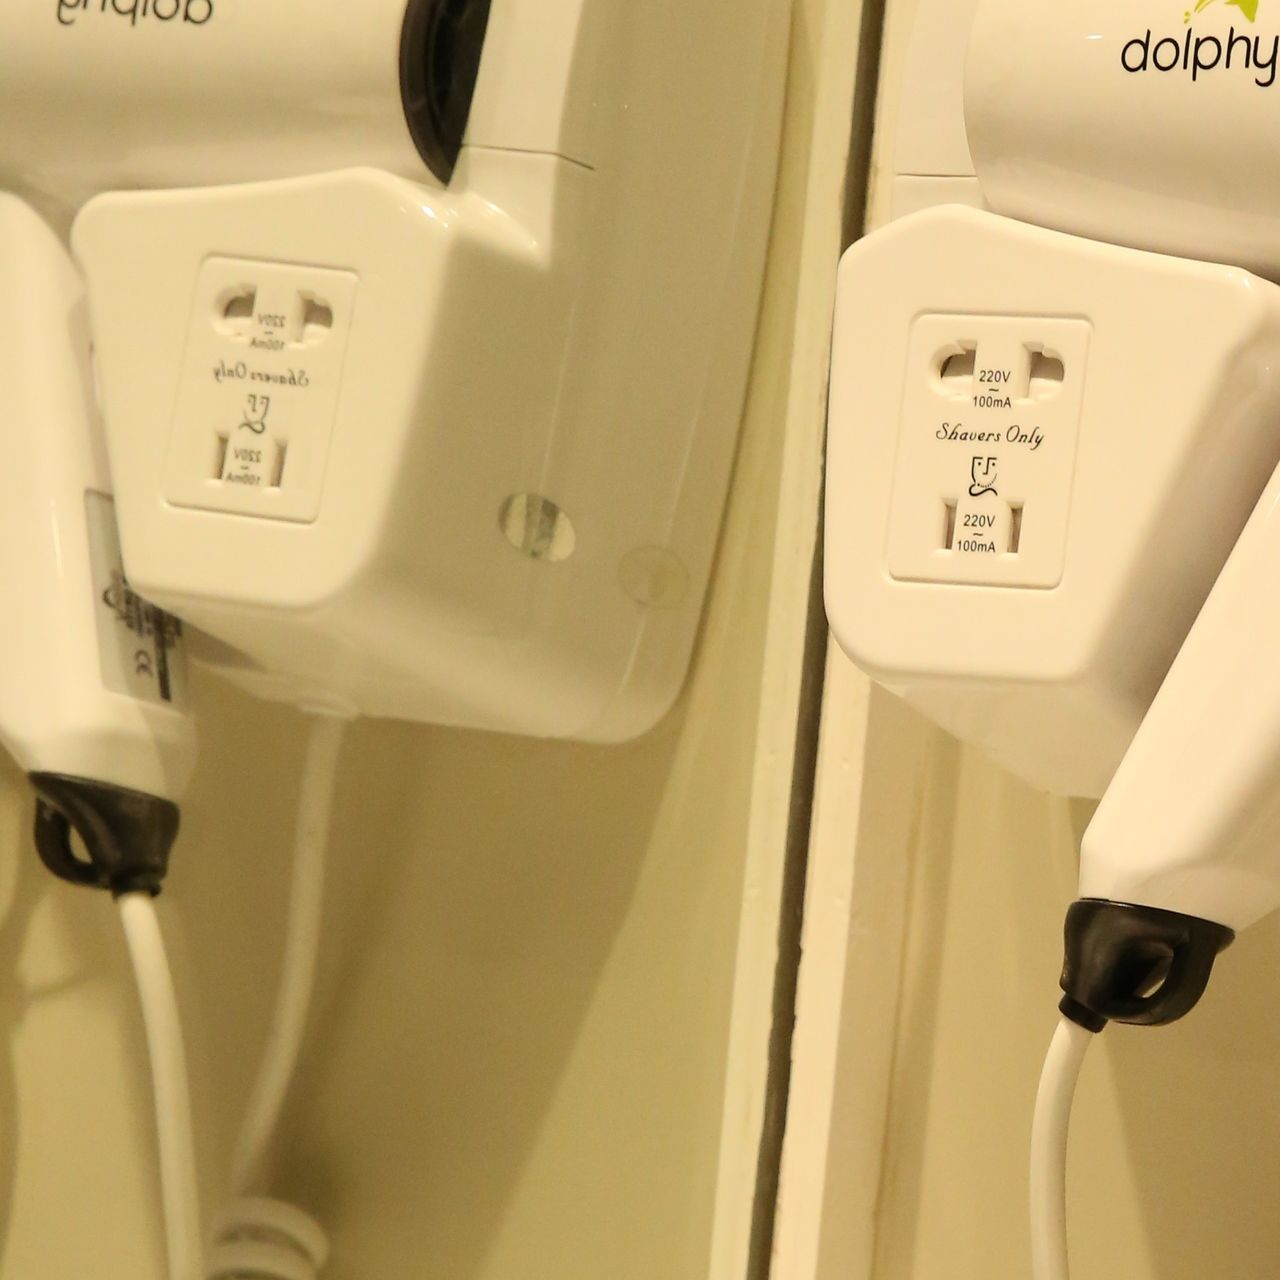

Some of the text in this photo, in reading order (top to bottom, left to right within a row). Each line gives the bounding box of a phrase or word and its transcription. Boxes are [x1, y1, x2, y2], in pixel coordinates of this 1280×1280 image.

[978, 369, 1012, 384] 220V
[972, 395, 1012, 409] 100mA
[935, 422, 1045, 451] Shavers Only
[962, 514, 996, 528] 220V
[956, 540, 997, 553] 100mA
